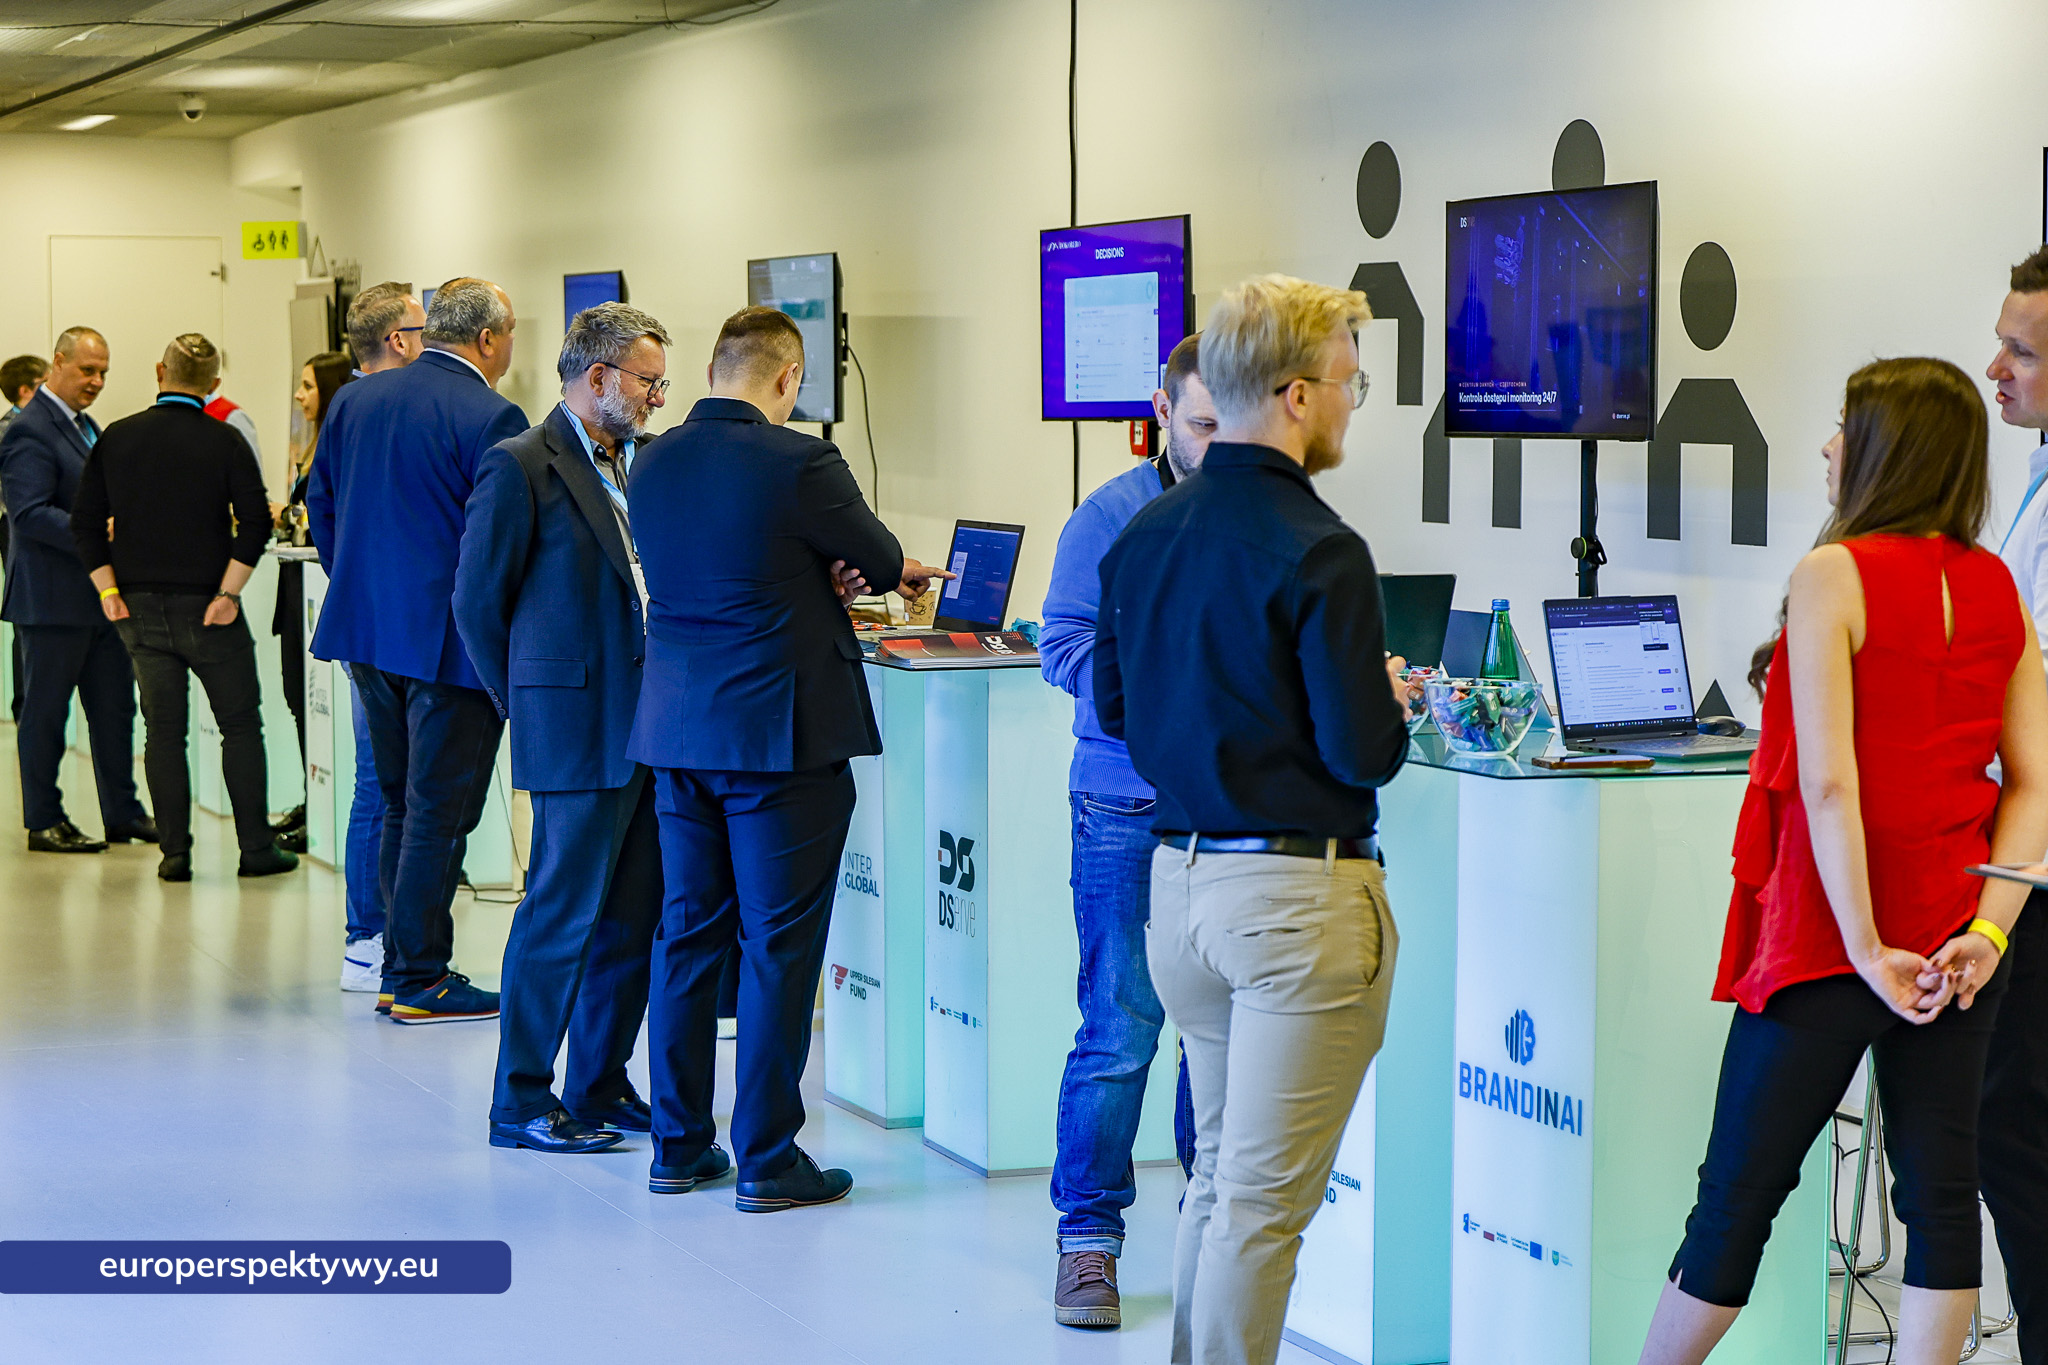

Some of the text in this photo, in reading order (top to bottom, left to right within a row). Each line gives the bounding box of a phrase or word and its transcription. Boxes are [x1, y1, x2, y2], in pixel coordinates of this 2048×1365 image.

[1095, 246, 1125, 260] DECISIONS
[1459, 391, 1483, 403] Kontrola
[1483, 391, 1507, 406] dostępu
[1510, 391, 1542, 405] monitoring
[1542, 390, 1557, 404] 24/7
[844, 850, 872, 876] INTER
[844, 872, 880, 898] GLOBAL
[939, 889, 976, 938] DServe
[850, 969, 881, 989] UPPER SILESIAN
[849, 982, 867, 1001] FUND
[1459, 1061, 1583, 1137] BRANDINAI
[1331, 1170, 1361, 1192] SILESIAN
